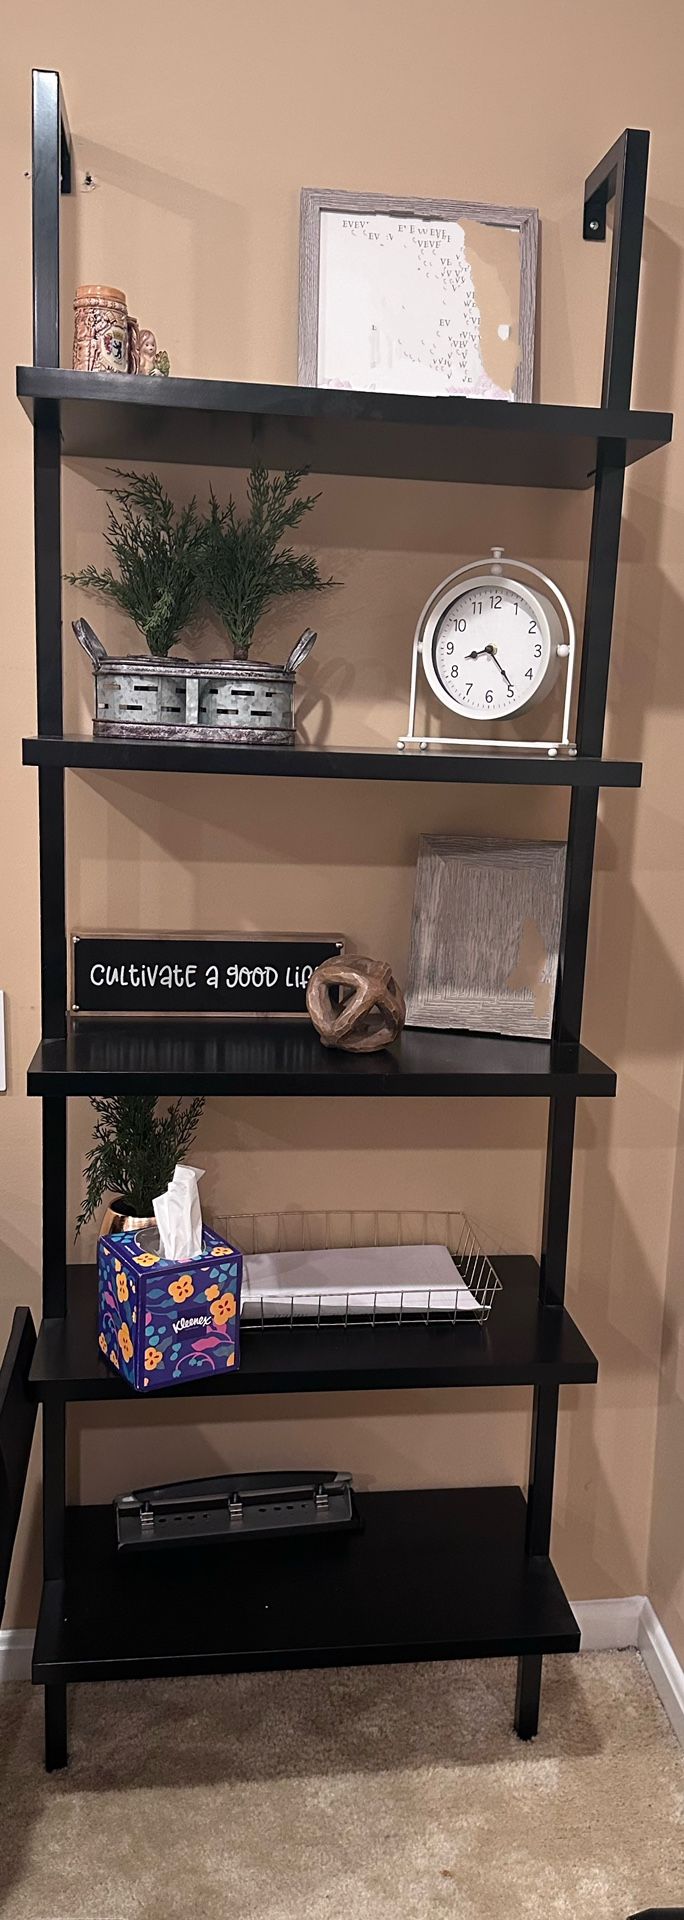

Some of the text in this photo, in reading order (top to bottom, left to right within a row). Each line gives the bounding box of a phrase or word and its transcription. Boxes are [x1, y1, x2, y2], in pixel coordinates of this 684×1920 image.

[471, 602, 482, 615] 11
[489, 596, 502, 609] 12
[513, 603, 519, 615] 1
[453, 619, 466, 632] 10
[528, 621, 537, 634] 2
[446, 642, 455, 655] 9
[533, 645, 542, 658] 3
[450, 665, 459, 678] 8
[524, 668, 533, 680] 4
[465, 683, 473, 696] 7
[506, 686, 514, 698] 5
[485, 690, 493, 703] 6
[205, 965, 219, 989] a
[286, 965, 319, 989] Lif
[172, 1316, 212, 1334] Kleenex
